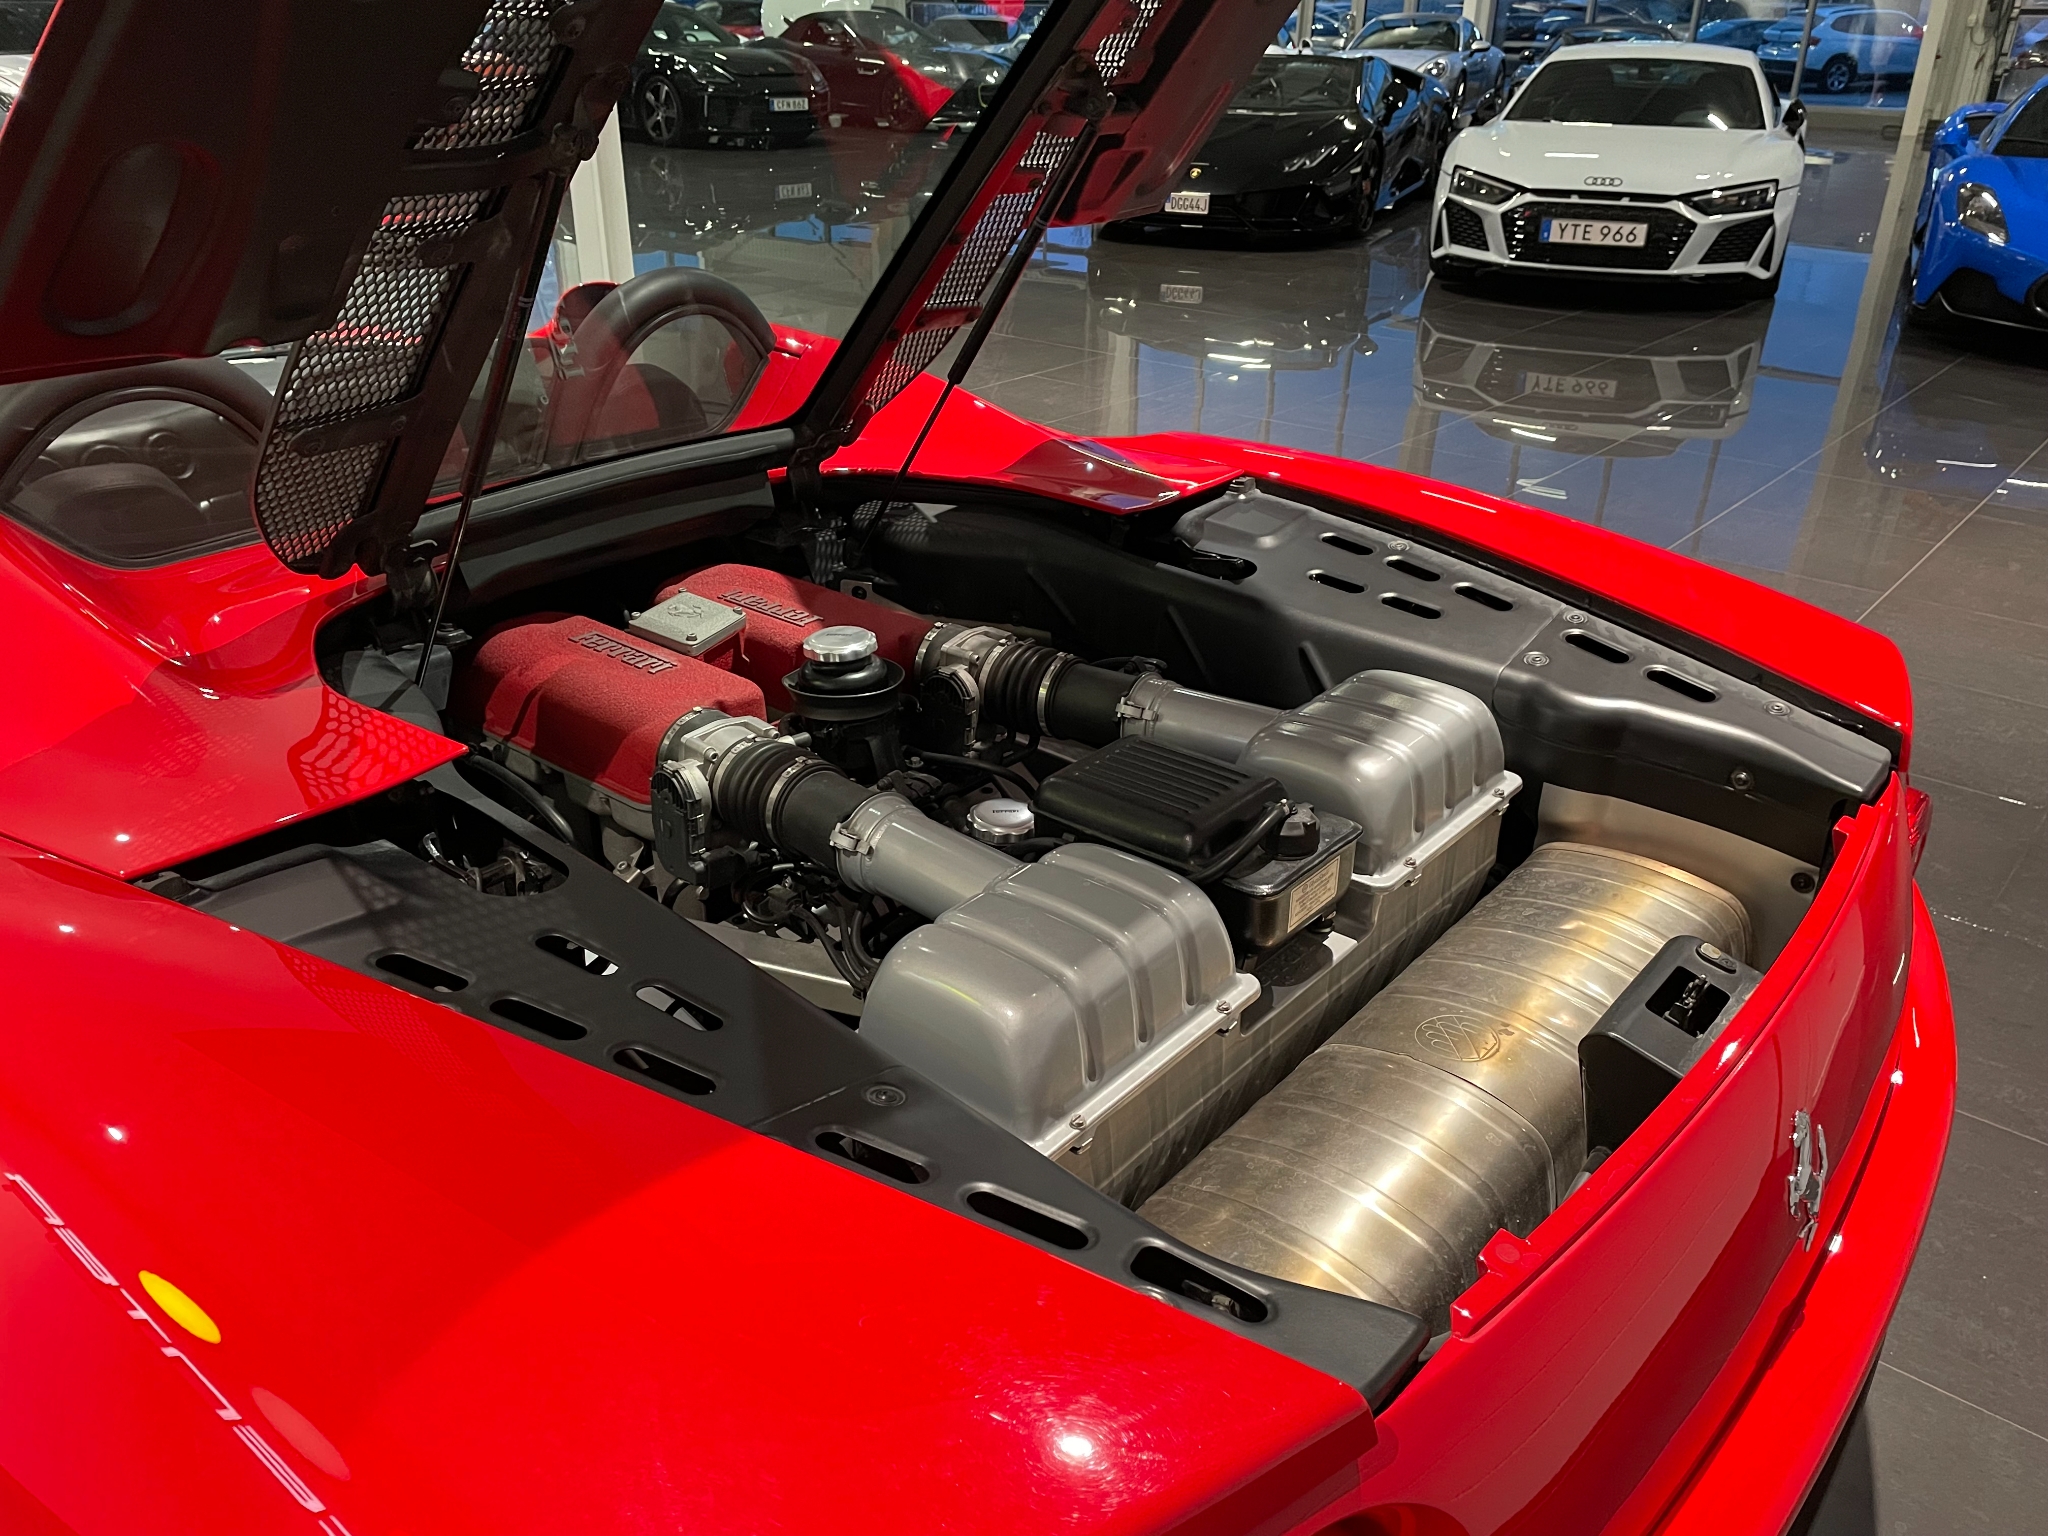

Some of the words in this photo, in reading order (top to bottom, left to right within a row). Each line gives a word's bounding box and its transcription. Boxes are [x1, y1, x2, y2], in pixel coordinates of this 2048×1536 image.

[1171, 197, 1208, 212] DGG44J
[1558, 222, 1593, 241] YTE
[1600, 225, 1637, 243] 966
[717, 589, 824, 627] Ferrari
[568, 630, 678, 675] Ferrari
